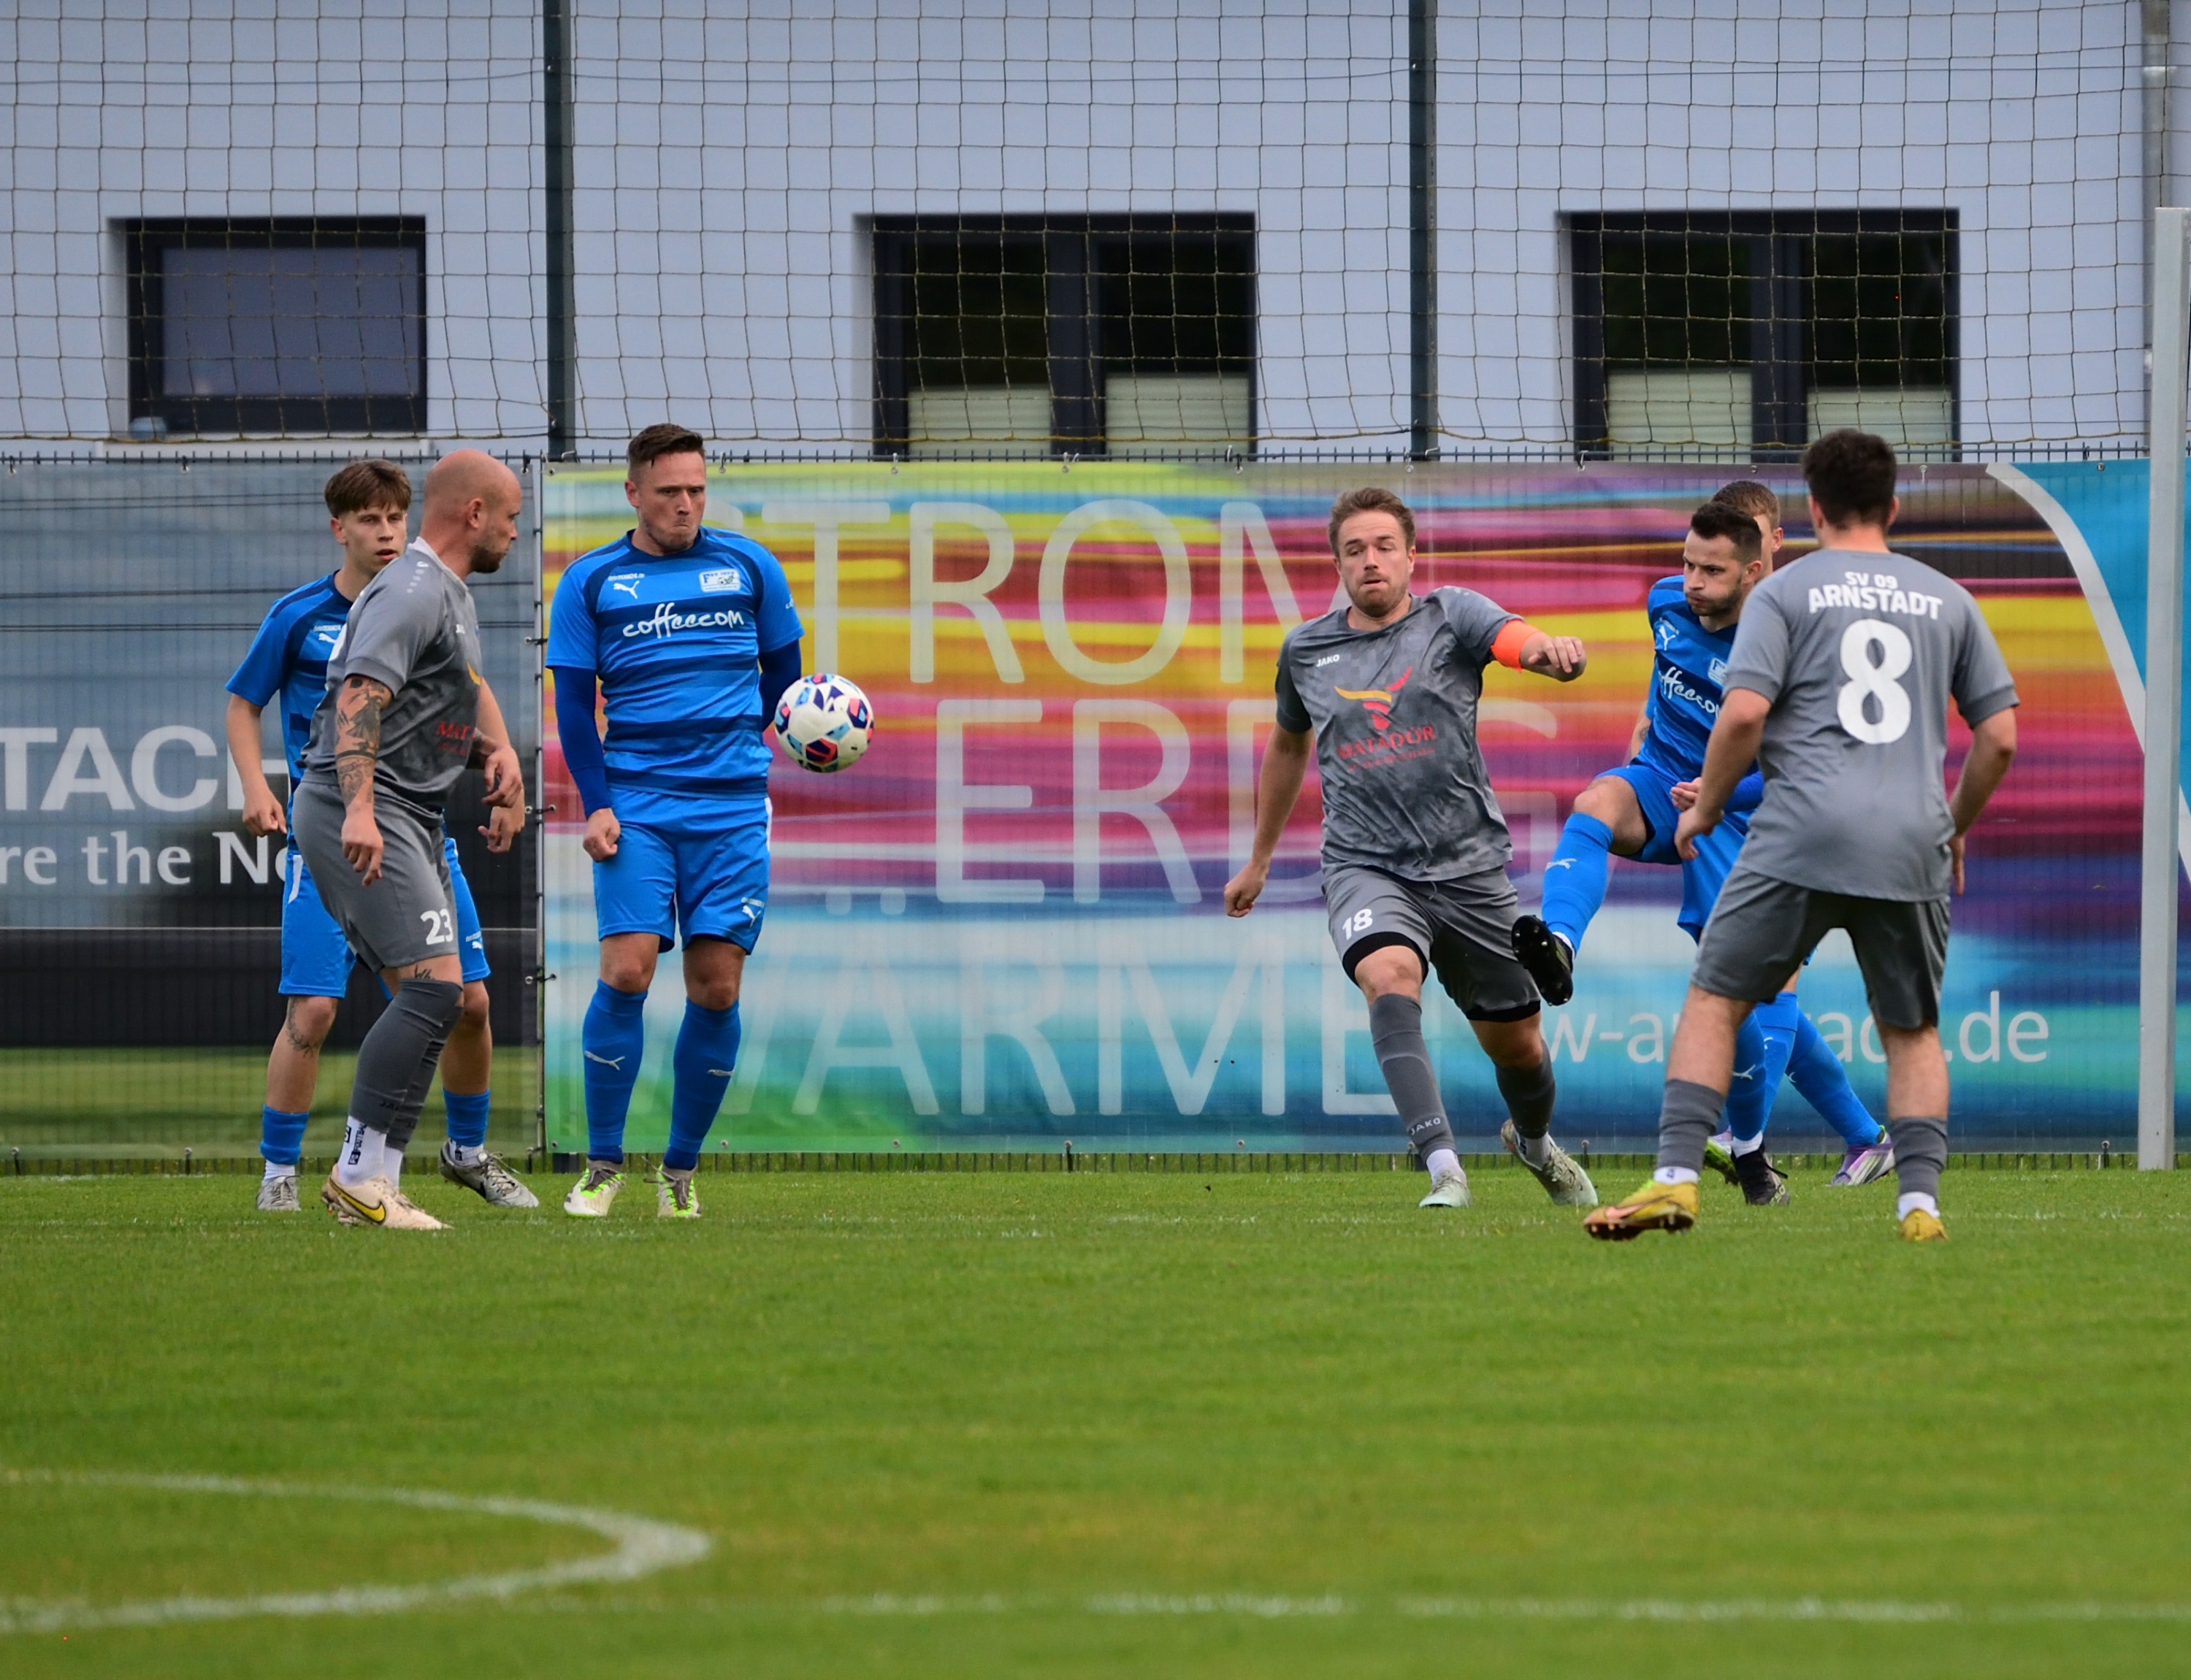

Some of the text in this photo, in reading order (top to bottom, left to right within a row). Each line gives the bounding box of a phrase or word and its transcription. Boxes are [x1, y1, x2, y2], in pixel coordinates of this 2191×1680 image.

[1845, 571, 1898, 590] SV 09
[622, 602, 744, 639] coffeecom
[1808, 584, 1943, 621] ARNSTADT
[1316, 654, 1340, 667] JAKO
[1837, 618, 1913, 745] 8
[1337, 724, 1437, 759] MATADOR
[81, 830, 192, 885] the
[420, 908, 453, 945] 23
[1342, 908, 1373, 941] 18
[1411, 1117, 1441, 1135] JAKO
